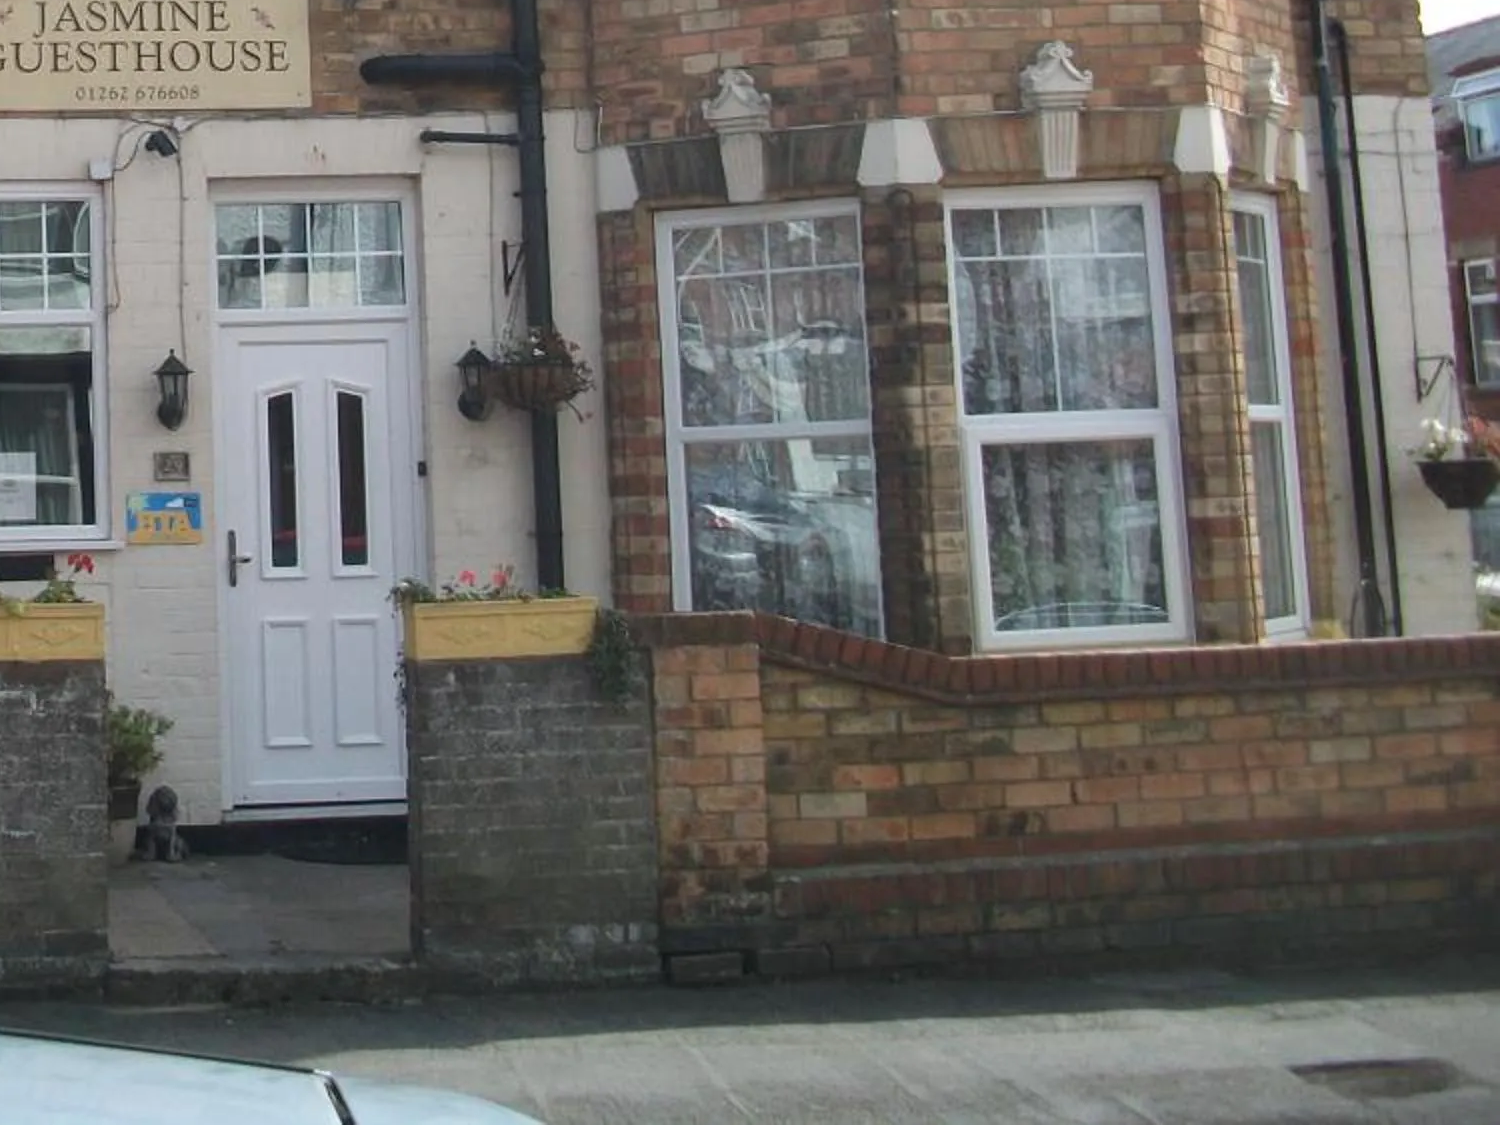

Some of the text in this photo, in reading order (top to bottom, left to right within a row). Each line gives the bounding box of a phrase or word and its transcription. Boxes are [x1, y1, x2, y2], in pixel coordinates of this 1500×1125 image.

[33, 0, 231, 38] JASMINE
[75, 85, 200, 102] 01262 676608
